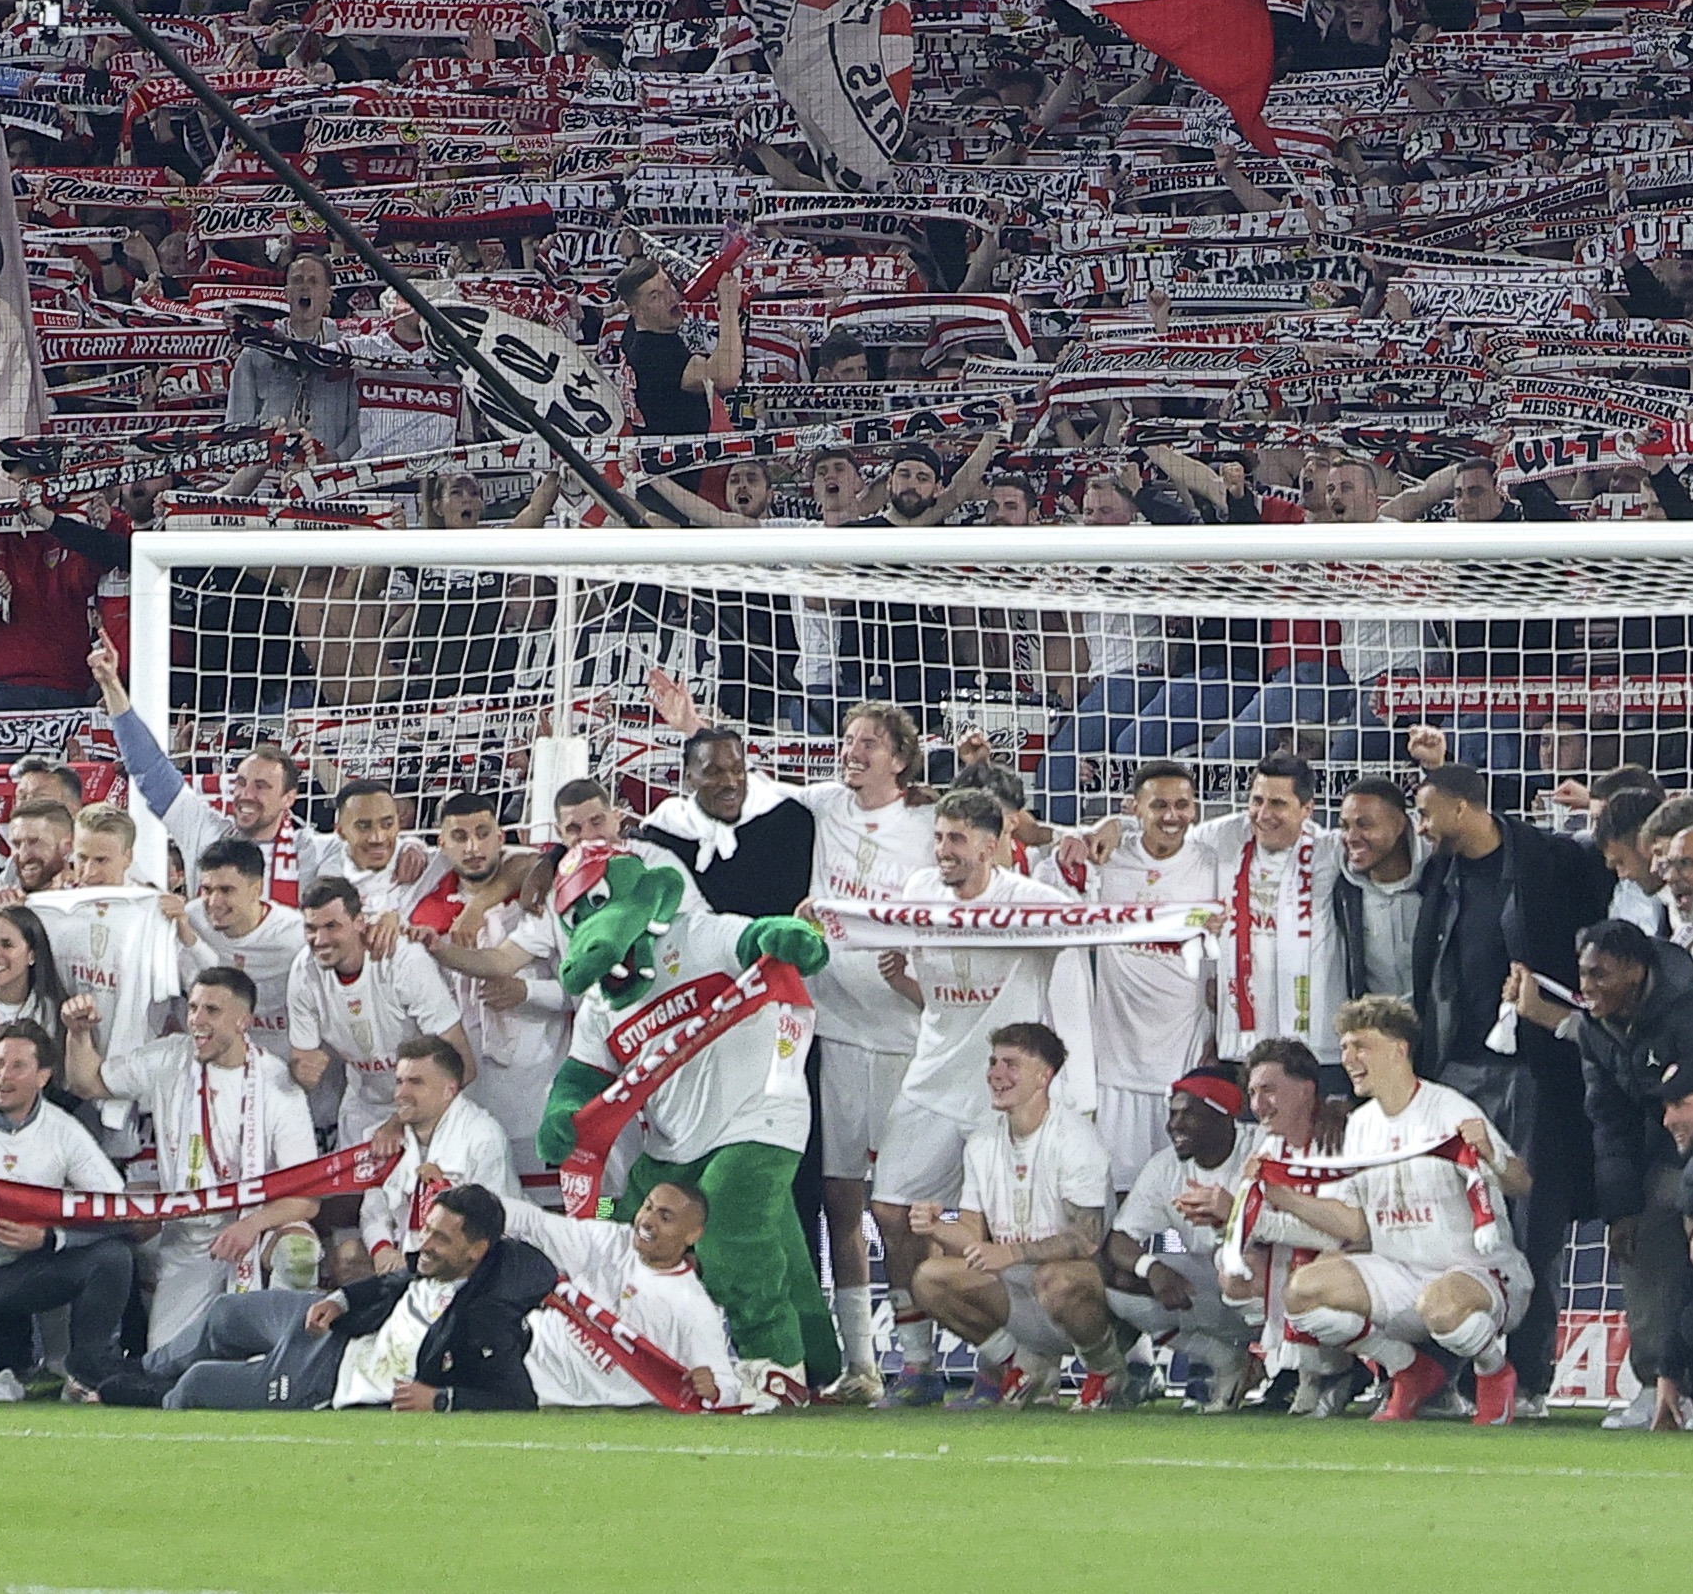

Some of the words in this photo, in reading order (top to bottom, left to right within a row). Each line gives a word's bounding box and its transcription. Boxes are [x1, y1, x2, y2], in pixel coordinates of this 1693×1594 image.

[336, 5, 383, 34] VfB
[388, 5, 528, 35] STUTTGART
[309, 118, 385, 145] POWER
[48, 177, 149, 203] POWER
[1149, 175, 1212, 193] HEISST
[196, 206, 275, 233] POWER
[362, 384, 454, 408] ULTRAS
[1516, 379, 1608, 405] BRUSTRING
[1520, 399, 1578, 421] HEISST
[53, 415, 205, 434] POKALFINALE
[210, 515, 246, 526] ULTRAS
[829, 877, 891, 903] FINALE
[947, 904, 1157, 929] STUTTGART
[616, 987, 699, 1055] STUTTGART
[62, 1179, 267, 1218] FINALE
[1376, 1208, 1435, 1225] FINALE
